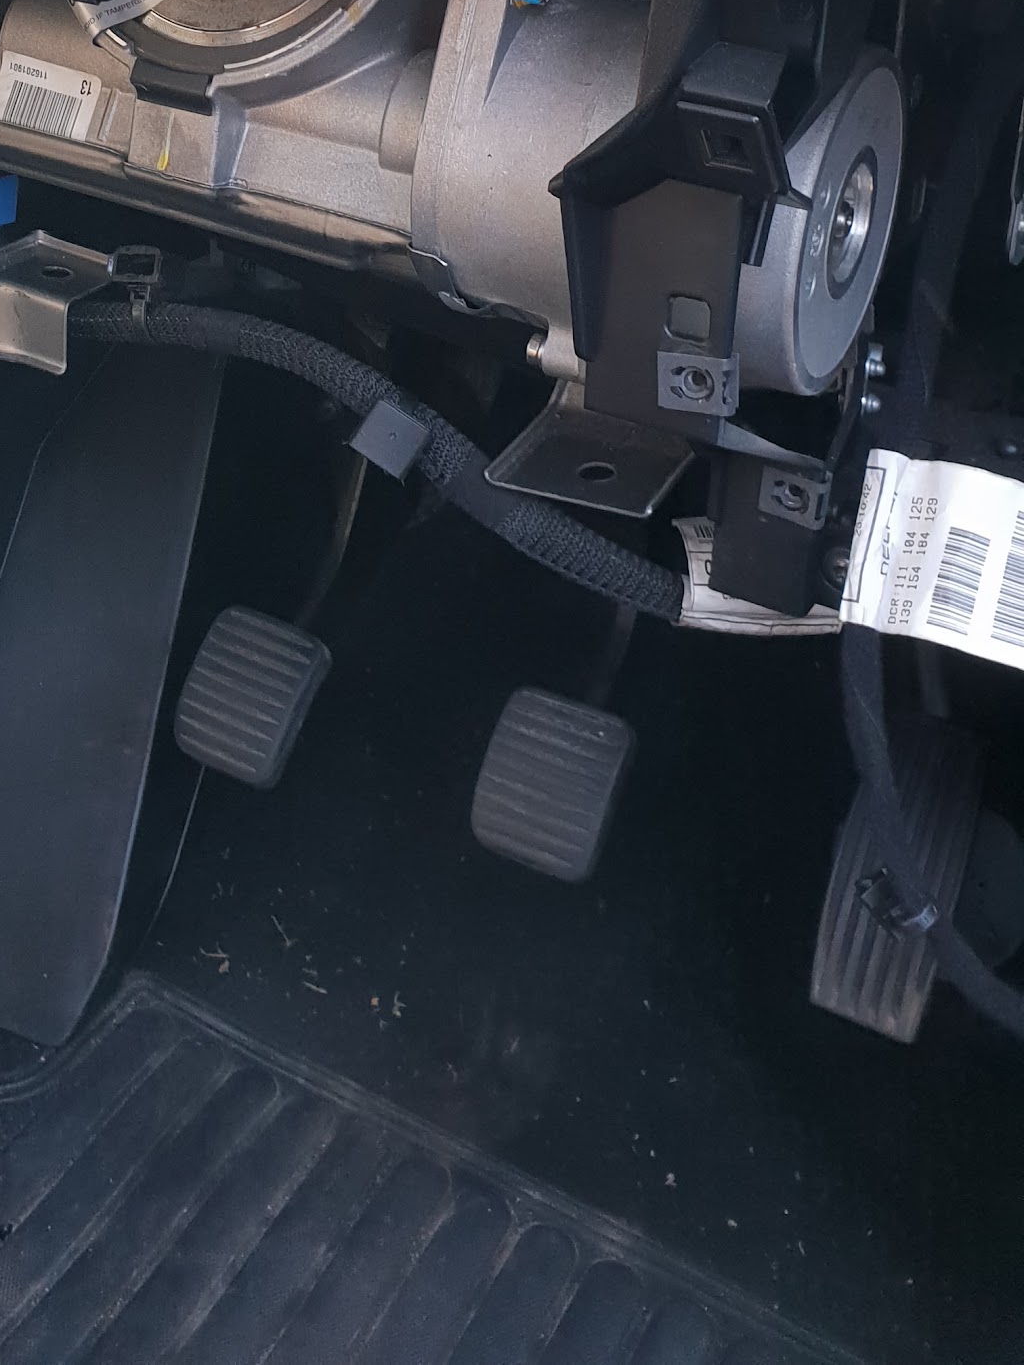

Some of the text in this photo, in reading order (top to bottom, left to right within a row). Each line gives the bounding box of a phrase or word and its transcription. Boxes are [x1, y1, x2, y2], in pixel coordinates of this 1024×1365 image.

[80, 79, 92, 96] 13
[909, 496, 924, 521] 125
[899, 599, 913, 624] 139
[908, 566, 922, 589] 154
[925, 497, 939, 522] 129
